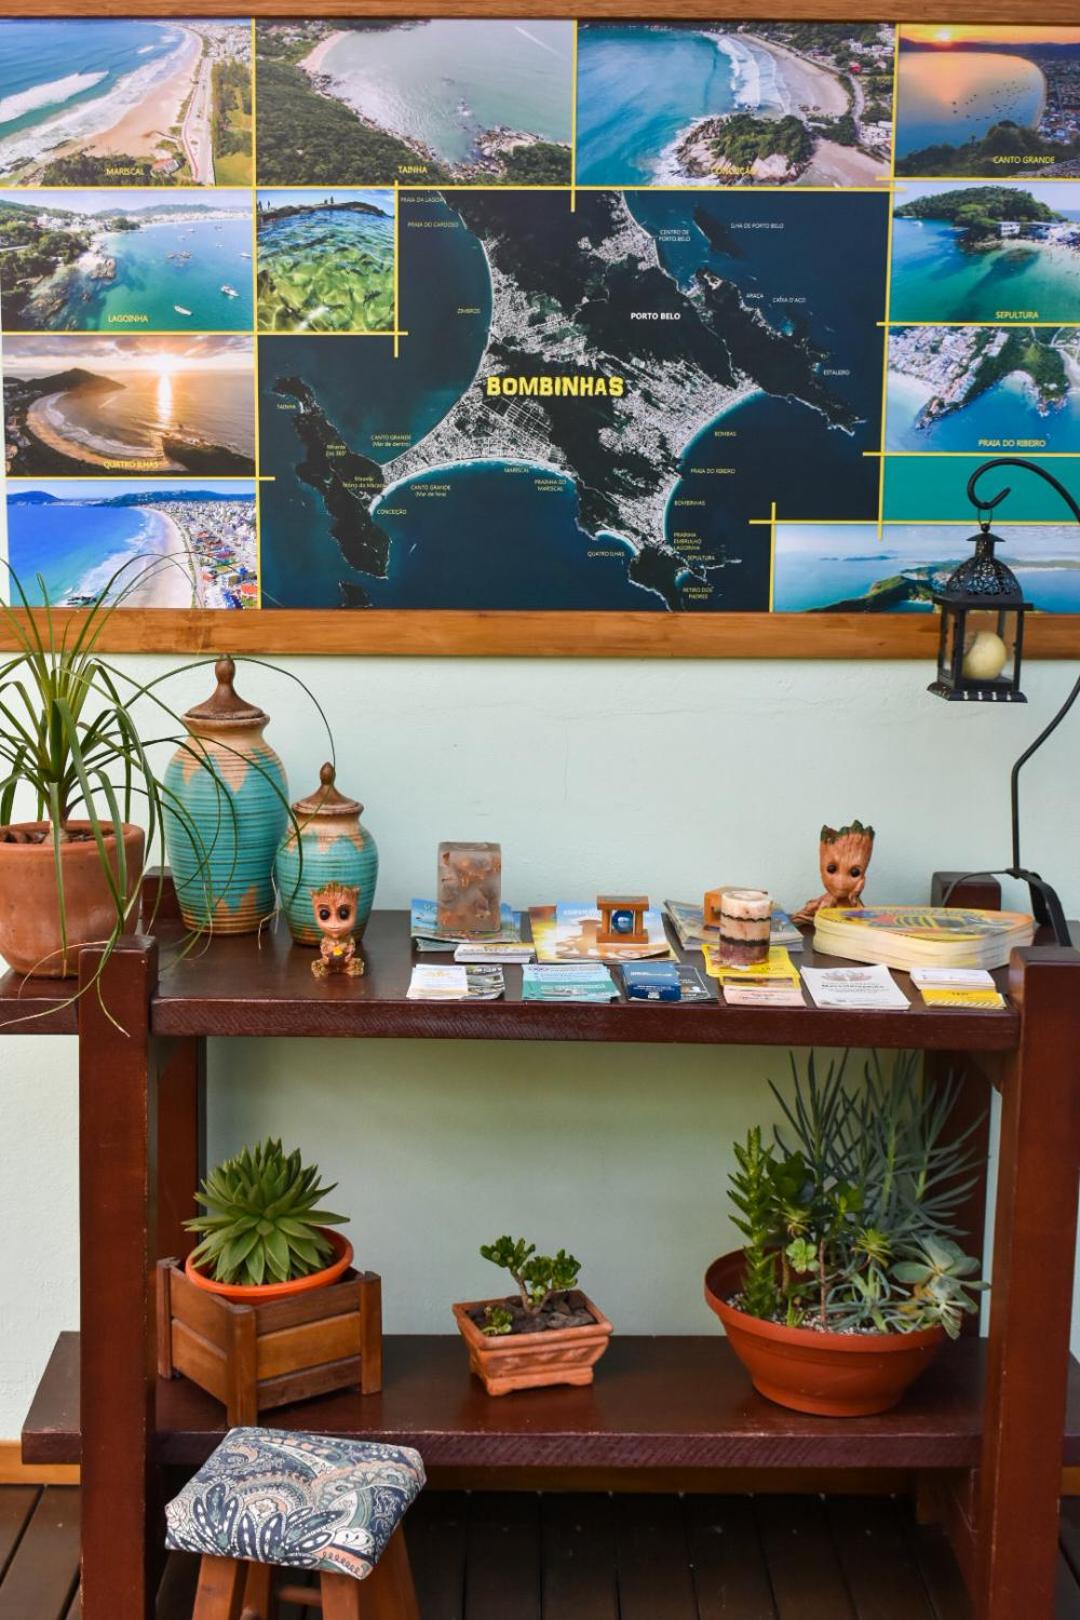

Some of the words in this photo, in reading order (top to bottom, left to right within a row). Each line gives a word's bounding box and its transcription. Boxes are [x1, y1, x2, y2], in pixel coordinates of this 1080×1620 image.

[992, 155, 1021, 164] CANTO
[1022, 155, 1056, 164] GRANDE
[106, 167, 144, 176] MARISCAL
[107, 314, 149, 323] LAGOINHA
[630, 312, 659, 321] PORTO
[660, 312, 681, 321] BELO
[995, 311, 1040, 319] SEPULTURA
[486, 376, 624, 397] BOMBINHAS
[978, 439, 1001, 447] PRAIA
[1002, 439, 1015, 447] DO
[1016, 439, 1047, 447] RIBEIRO
